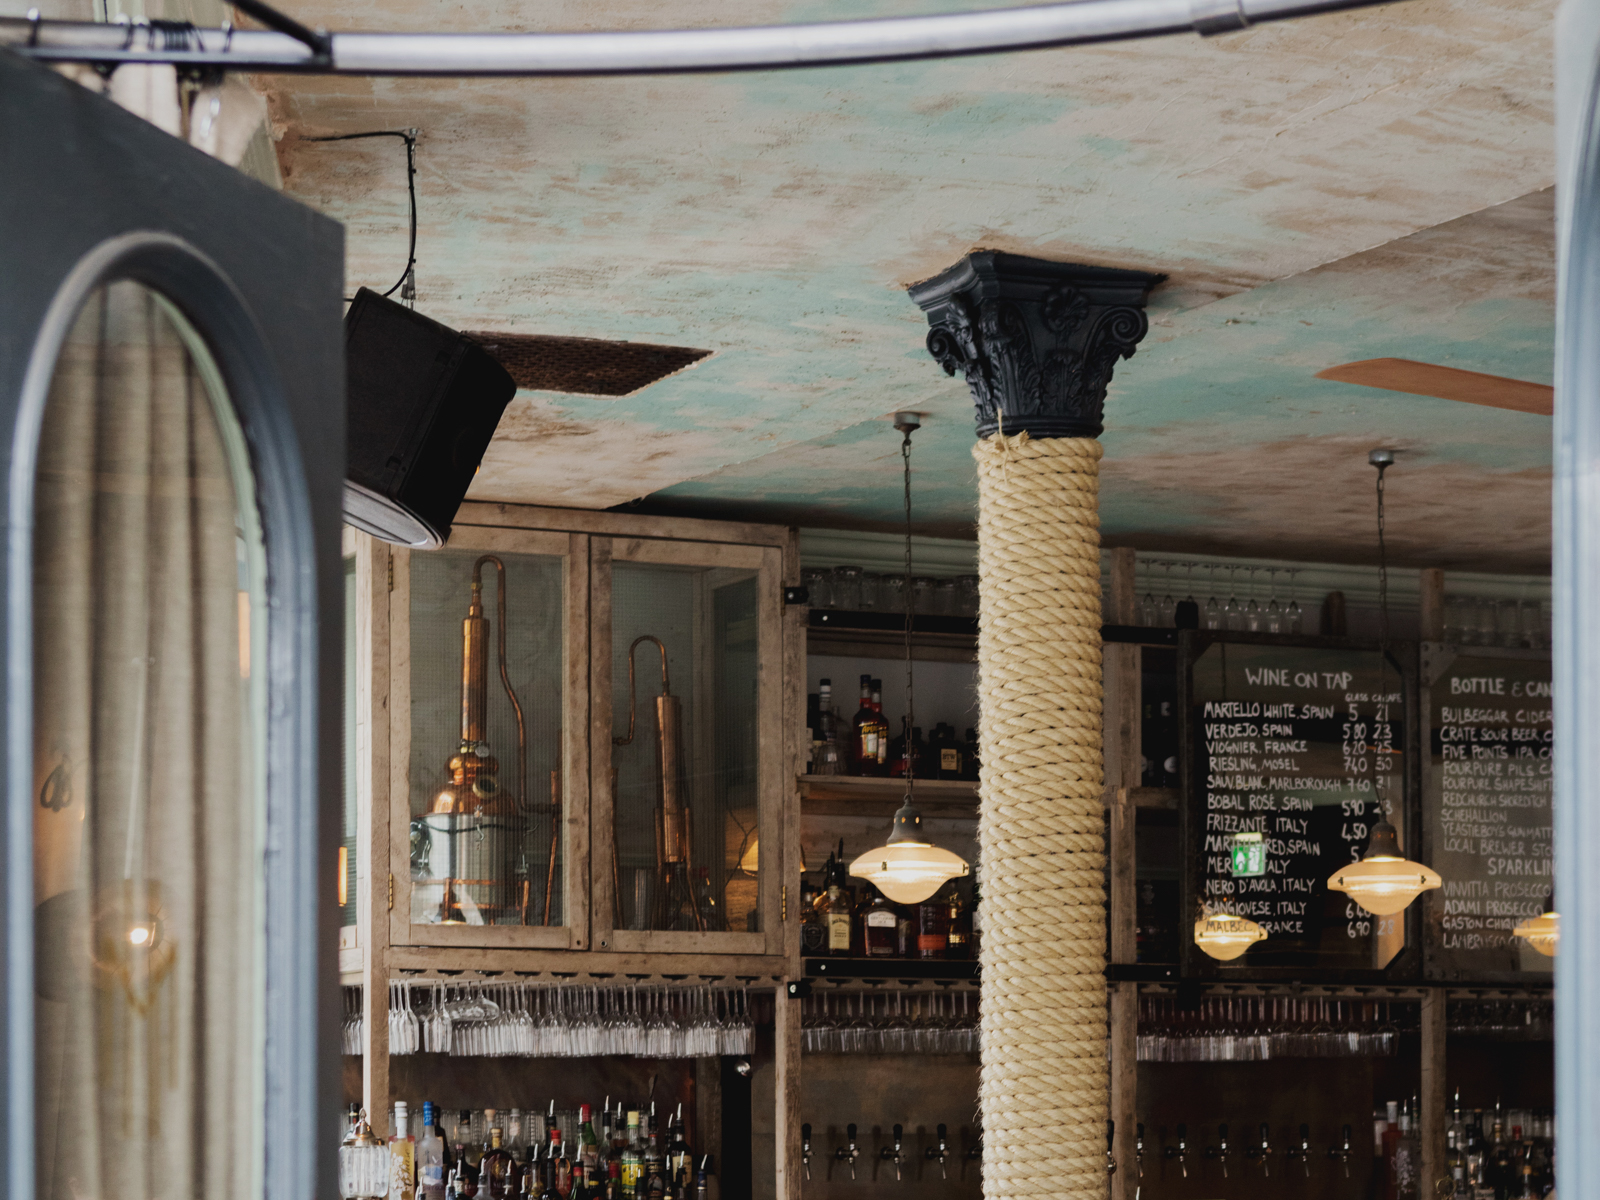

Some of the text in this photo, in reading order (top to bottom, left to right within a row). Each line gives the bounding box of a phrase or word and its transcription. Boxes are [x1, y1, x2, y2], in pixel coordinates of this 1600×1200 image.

[1246, 668, 1353, 690] WINE ON TAP
[1450, 677, 1505, 695] BOTTLE
[1345, 693, 1368, 702] GLASS
[1203, 701, 1260, 719] MARTELLO
[1300, 704, 1335, 720] SPAIN
[1348, 703, 1359, 722] 5
[1441, 706, 1510, 724] BULBEGGAR
[1262, 723, 1293, 737] SPAIN
[1440, 725, 1478, 742] CRATE
[1480, 728, 1508, 742] SOUR
[1264, 740, 1308, 754] FRANCE
[1442, 744, 1467, 760] FIVE
[1471, 744, 1508, 760] POINTS
[1262, 759, 1300, 771] MOSEL
[1443, 761, 1503, 776] FOURPURE
[1269, 776, 1341, 792] MARLBOROUGH
[1442, 776, 1492, 791] FOURPURE
[1207, 793, 1244, 810] BOBAL
[1281, 796, 1313, 811] SPAIN
[1441, 808, 1507, 823] SCHEHALLION
[1275, 817, 1308, 835] ITALY
[1288, 839, 1321, 857] SPAIN
[1444, 837, 1476, 854] LOCAL
[1480, 839, 1526, 856] BREWER
[1206, 879, 1235, 896] NERO
[1282, 878, 1316, 894] ITALY
[1494, 881, 1551, 898] PROSECCO
[1277, 901, 1307, 916] ITALY
[1443, 899, 1543, 917] ADAMI PROSECCO
[1259, 921, 1304, 933] FRANCE
[1442, 915, 1484, 930] GASTON
